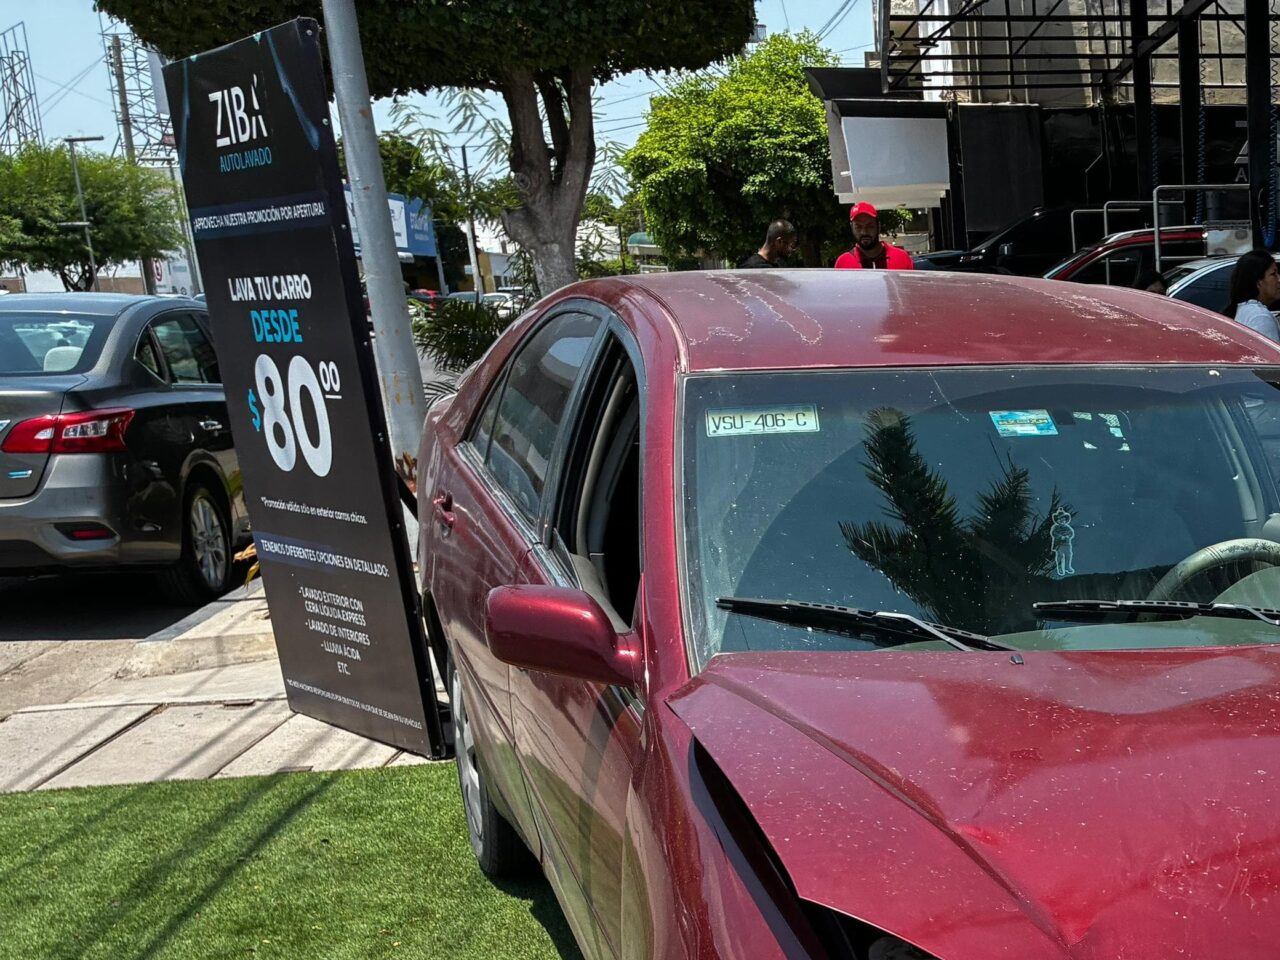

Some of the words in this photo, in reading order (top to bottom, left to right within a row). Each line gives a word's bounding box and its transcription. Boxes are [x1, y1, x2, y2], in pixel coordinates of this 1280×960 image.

[220, 146, 272, 173] AUTOLAVADO
[224, 212, 247, 226] NUESTRA
[247, 205, 280, 224] PROMOCIÓN
[280, 206, 293, 220] POR
[293, 202, 325, 218] APERTURA!
[228, 277, 257, 301] LAVA
[254, 276, 271, 301] TU
[272, 274, 312, 300] CARRO
[250, 309, 303, 342] DESDE
[711, 412, 807, 431] VSU-406-C
[261, 539, 285, 555] TENEMOS
[285, 544, 316, 561] DIFERENTES
[316, 550, 344, 568] OPCIONES
[344, 556, 353, 570] EN
[353, 558, 390, 577] DETALLADO:
[305, 601, 319, 614] CERA
[341, 609, 366, 626] EXPRESS
[323, 591, 350, 607] EXTERIOR
[349, 597, 364, 611] CON
[330, 625, 338, 637] DE
[338, 627, 370, 646] INTERIORES
